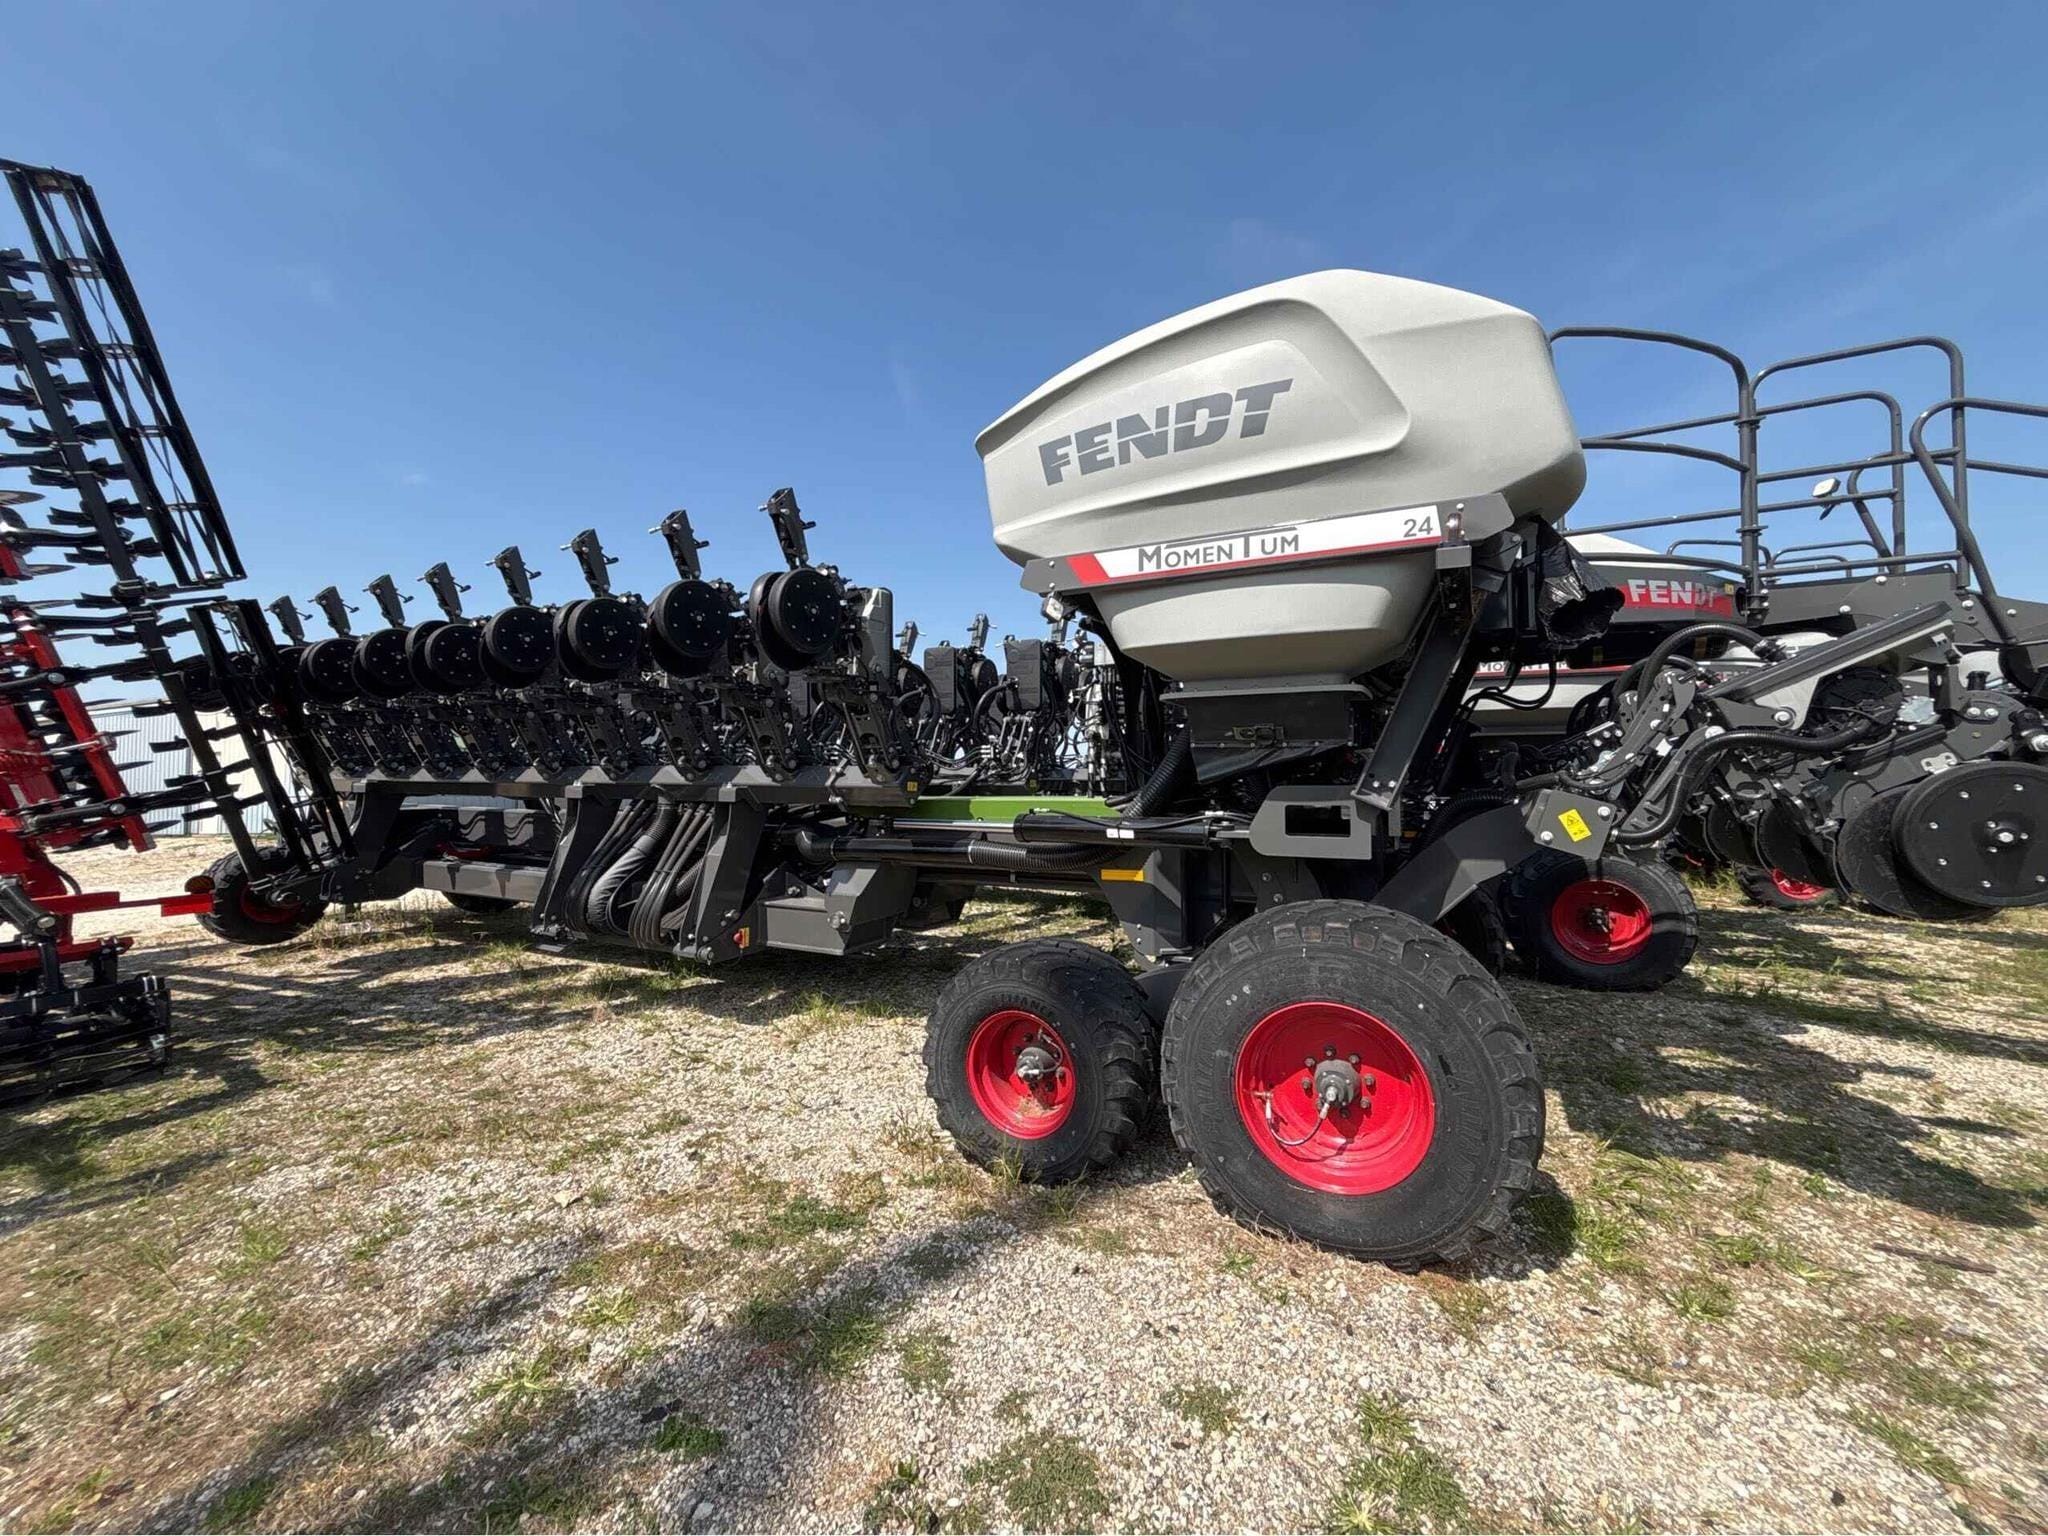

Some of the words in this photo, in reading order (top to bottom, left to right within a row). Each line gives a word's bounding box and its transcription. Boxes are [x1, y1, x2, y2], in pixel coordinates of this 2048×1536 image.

[1039, 379, 1294, 486] FENDT
[1403, 516, 1434, 538] 24
[1627, 579, 1718, 608] FENDT
